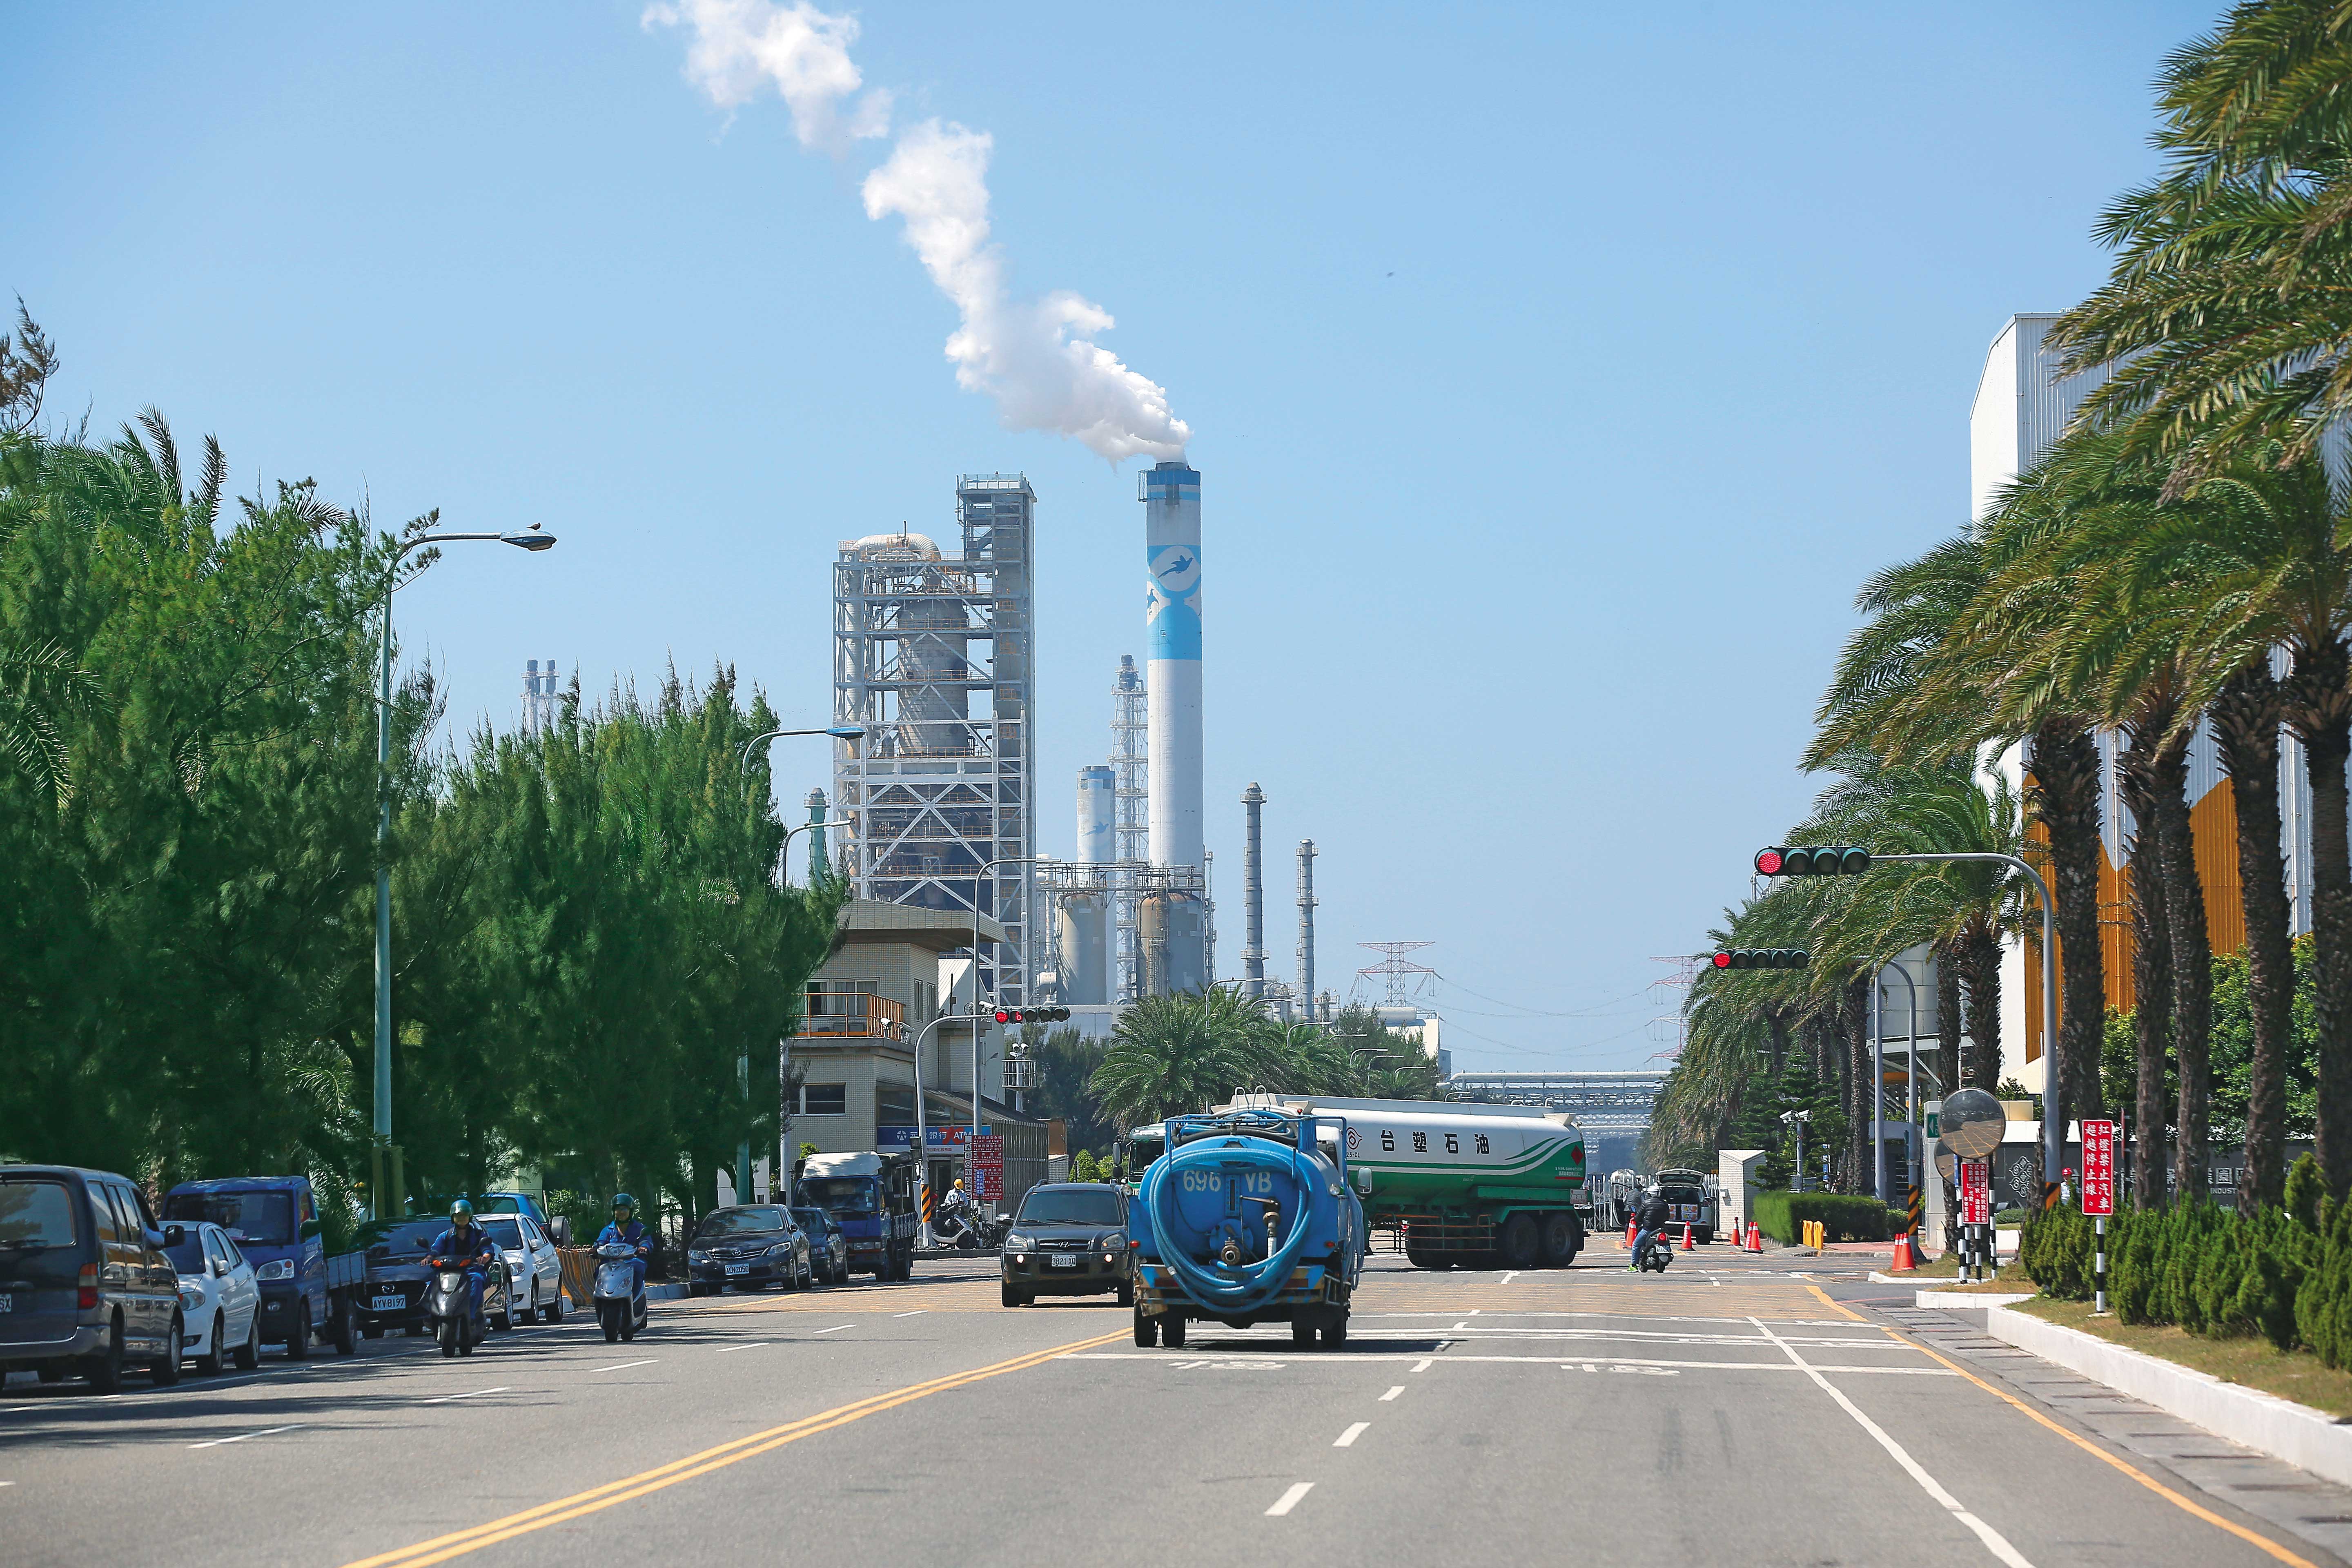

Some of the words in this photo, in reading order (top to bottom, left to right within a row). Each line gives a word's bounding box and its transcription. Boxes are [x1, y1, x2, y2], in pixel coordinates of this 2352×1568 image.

[910, 1131, 947, 1139] 元銀行
[953, 1131, 972, 1139] ATM
[1380, 1129, 1490, 1155] 台塑石油
[2098, 1123, 2110, 1211] 紅燈禁止汽車
[1183, 1170, 1221, 1192] 696
[1245, 1172, 1272, 1192] VB
